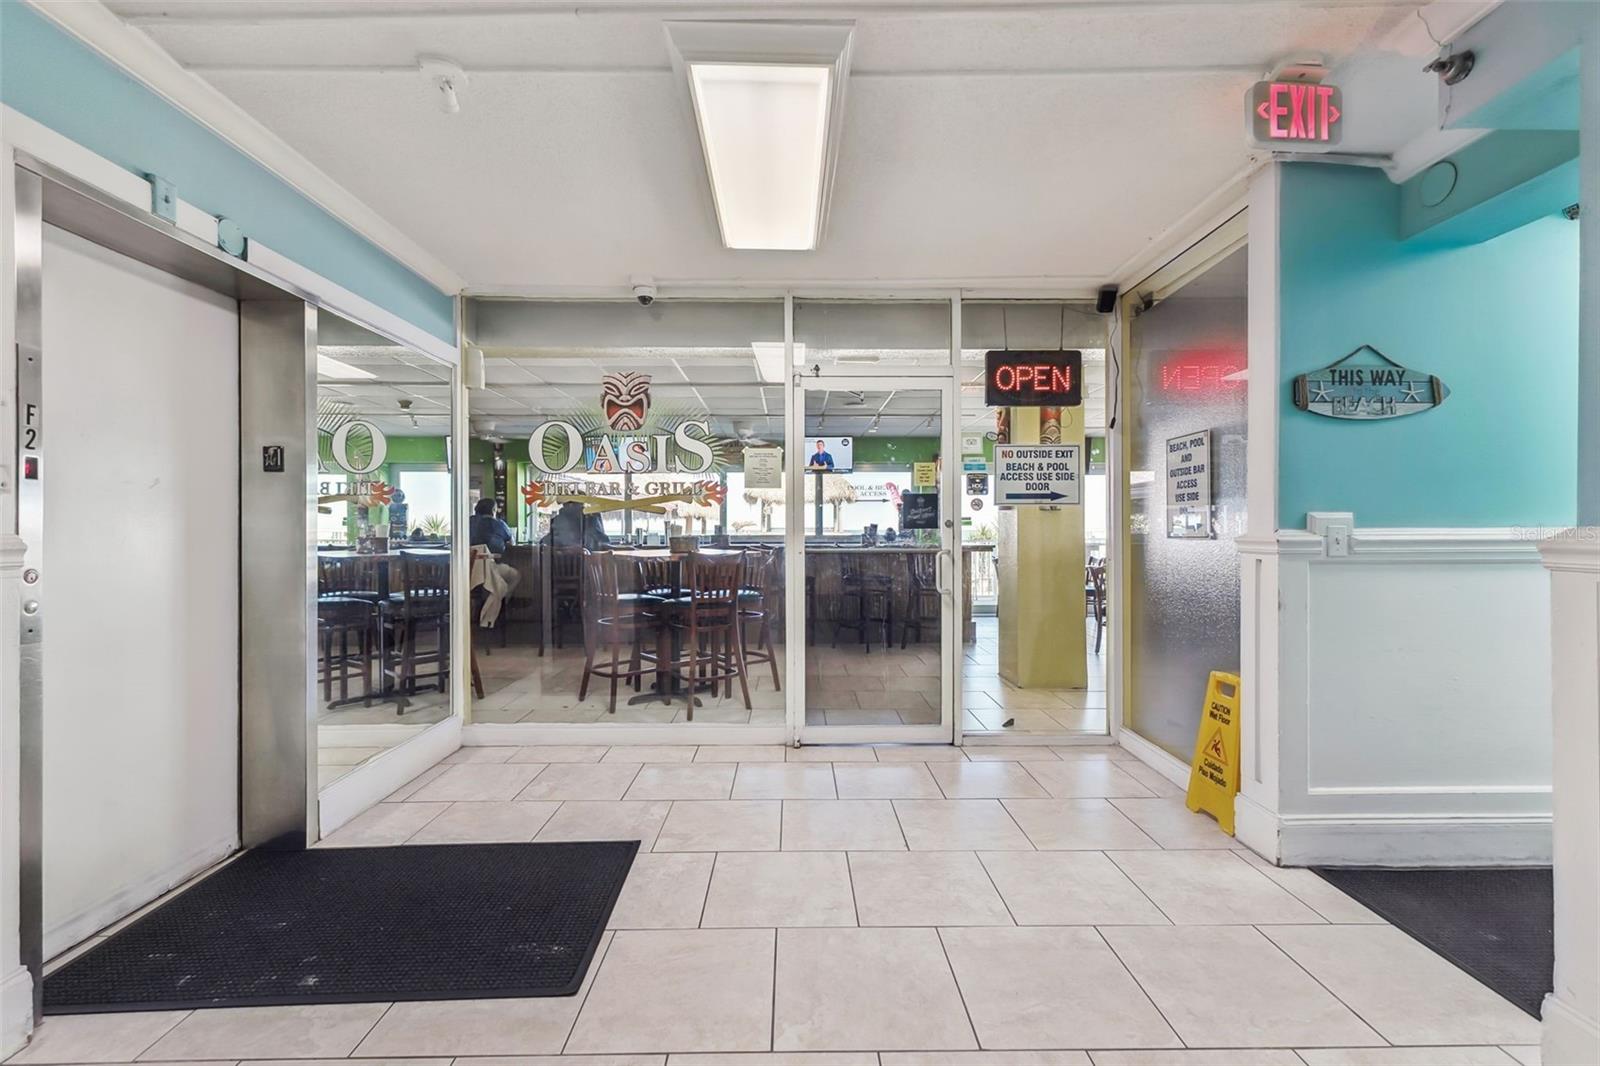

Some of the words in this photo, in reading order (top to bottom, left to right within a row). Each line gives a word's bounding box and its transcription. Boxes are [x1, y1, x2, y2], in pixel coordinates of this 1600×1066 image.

[1270, 83, 1333, 140] EXIT
[996, 366, 1071, 391] OPEN
[1329, 369, 1363, 386] THIS
[1370, 369, 1406, 386] WAY
[1332, 396, 1397, 415] BEACH
[528, 420, 714, 474] OASIS
[1190, 437, 1205, 448] POOL
[1002, 450, 1014, 458] NO
[1016, 450, 1052, 459] OUTSIDE
[1055, 450, 1074, 459] EXIT
[1181, 453, 1192, 463] AND
[1006, 463, 1035, 471] BEACH
[1037, 463, 1044, 471] &
[1047, 463, 1069, 471] POOL
[1169, 466, 1192, 478] OUTSIDE
[1193, 464, 1205, 475] BAR
[1000, 473, 1034, 481] ACCESS
[1036, 473, 1053, 481] USE
[1055, 473, 1075, 481] SIDE
[1176, 479, 1198, 489] ACCESS
[544, 481, 580, 495] TIKI
[584, 482, 622, 495] BAR
[627, 482, 640, 495] &
[645, 481, 702, 496] GRILL
[1025, 483, 1050, 491] DOOR
[1175, 493, 1185, 502] USE
[1187, 492, 1199, 502] SIDE
[1211, 702, 1231, 715] CAUTION
[1209, 710, 1219, 720] Wet
[1219, 713, 1231, 725] Floor
[1204, 758, 1223, 774] Cuidado
[1198, 765, 1209, 777] Piso
[1209, 771, 1226, 787] Mojado
